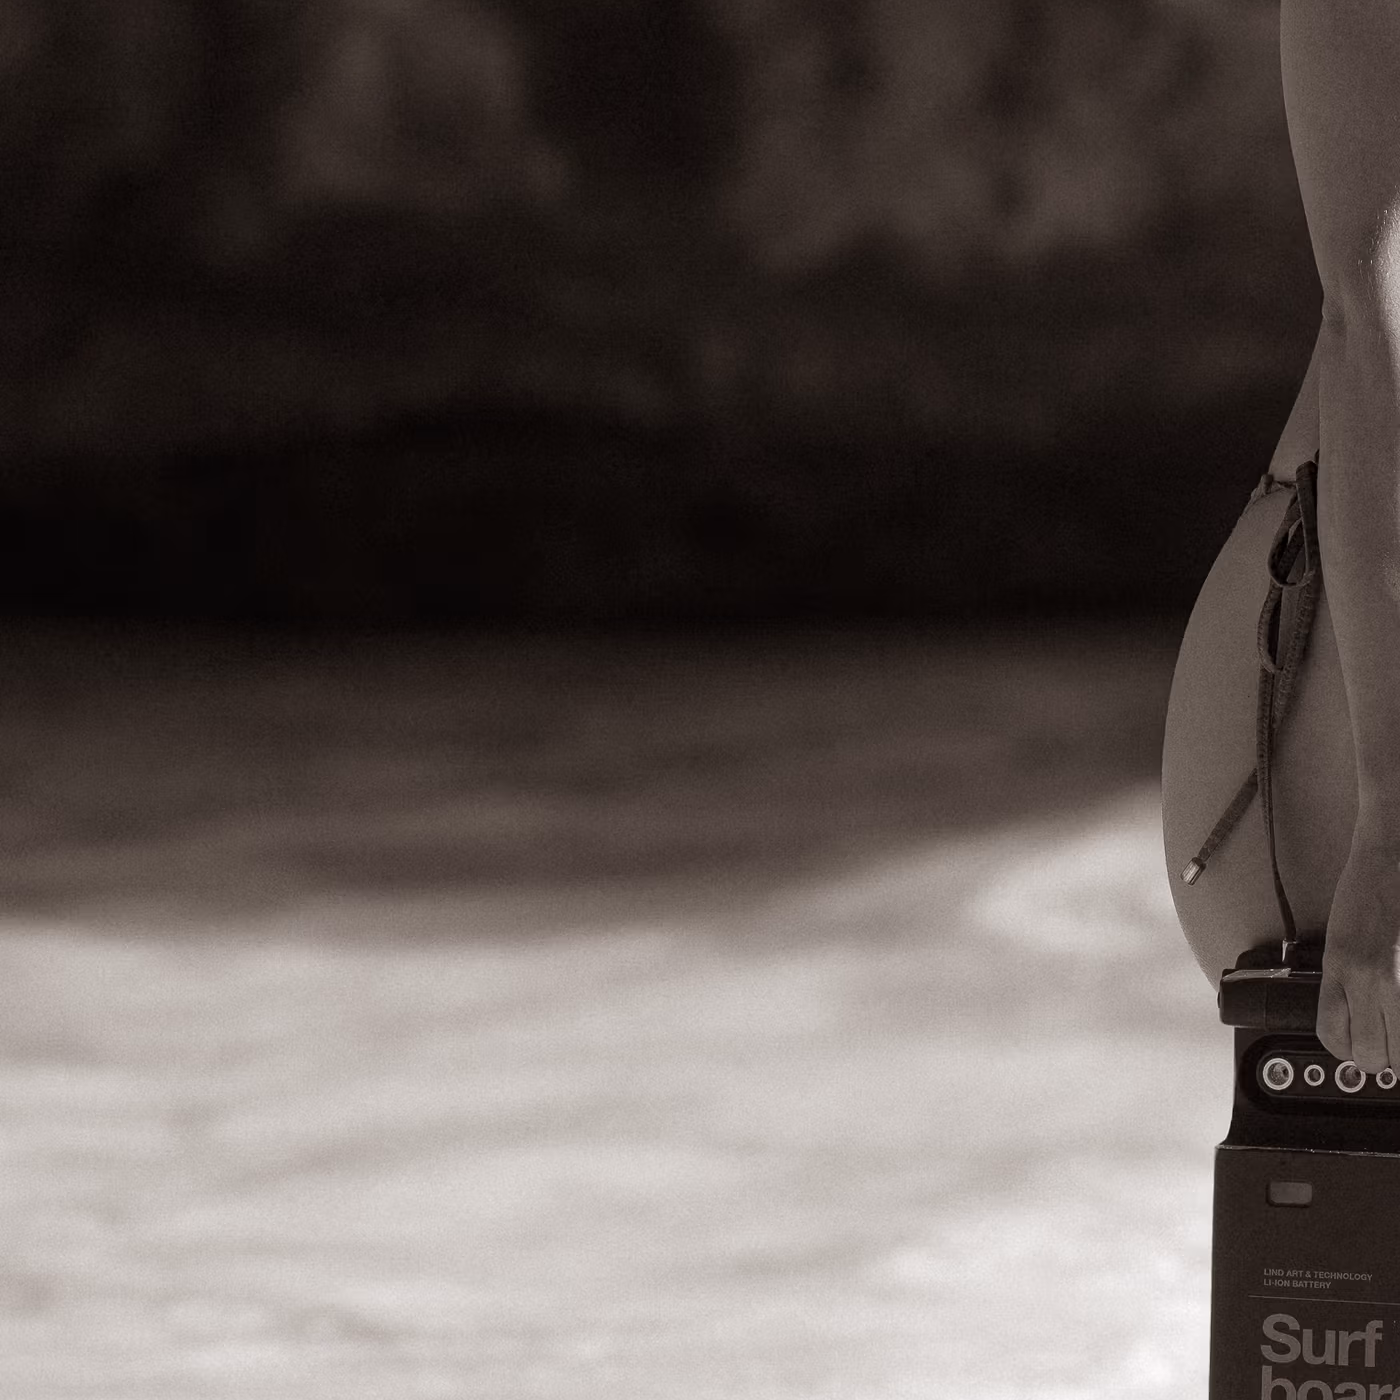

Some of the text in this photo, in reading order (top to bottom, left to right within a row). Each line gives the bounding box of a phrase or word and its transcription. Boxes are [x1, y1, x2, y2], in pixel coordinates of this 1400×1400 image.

[1263, 1268, 1284, 1277] LIND
[1286, 1269, 1304, 1278] ART
[1313, 1271, 1373, 1281] TECHNOLOGY
[1292, 1280, 1332, 1289] BATTERY
[1260, 1313, 1384, 1367] Surf
